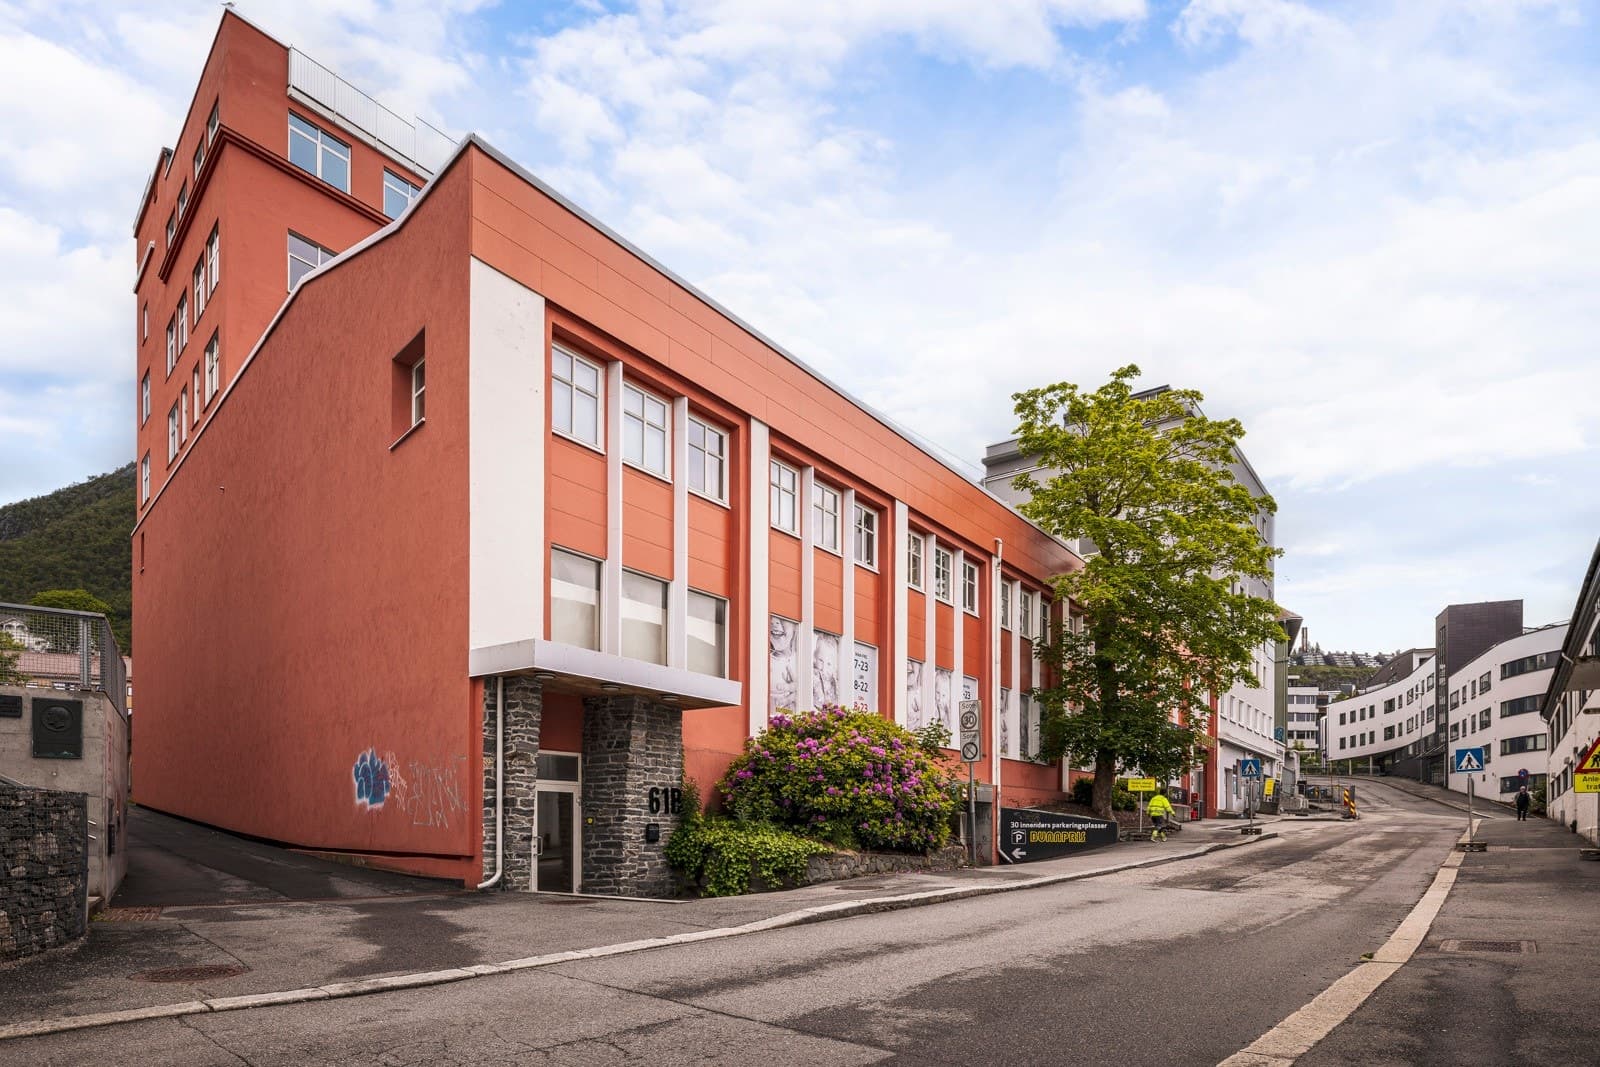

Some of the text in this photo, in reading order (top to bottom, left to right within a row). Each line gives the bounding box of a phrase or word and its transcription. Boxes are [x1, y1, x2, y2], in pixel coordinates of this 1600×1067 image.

[963, 715, 975, 725] 30
[649, 787, 682, 814] 61B
[1010, 821, 1019, 829] 30
[1051, 822, 1108, 830] parkeringsplasser
[1029, 831, 1087, 843] BUNNPRIS
